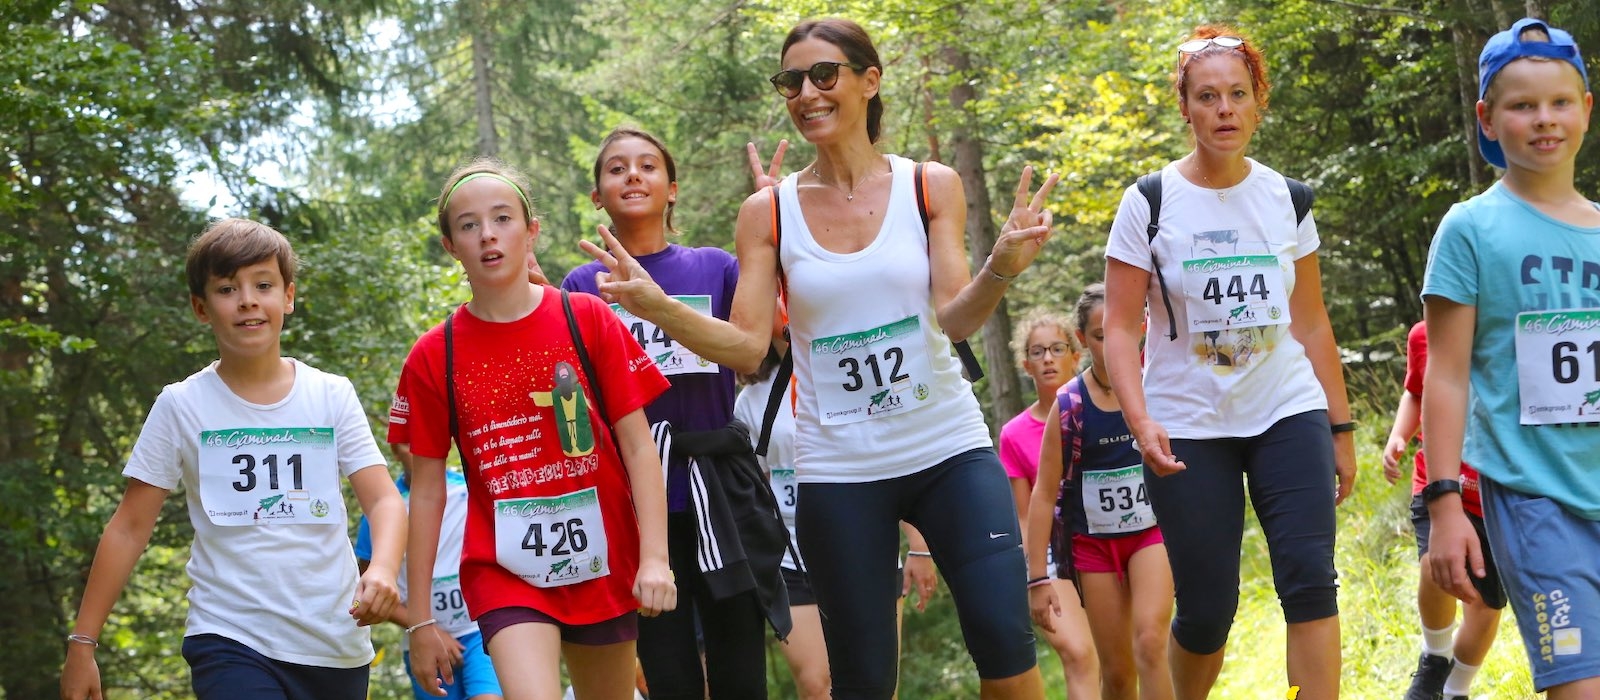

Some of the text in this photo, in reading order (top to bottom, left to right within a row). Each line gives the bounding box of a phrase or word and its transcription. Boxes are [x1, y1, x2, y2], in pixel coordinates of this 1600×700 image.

[1203, 273, 1270, 305] 444
[838, 346, 910, 392] 312
[231, 453, 303, 492] 311
[784, 485, 796, 507] 3
[1098, 482, 1150, 512] 534
[521, 517, 588, 557] 426
[433, 588, 464, 612] 30
[1549, 589, 1572, 628] city
